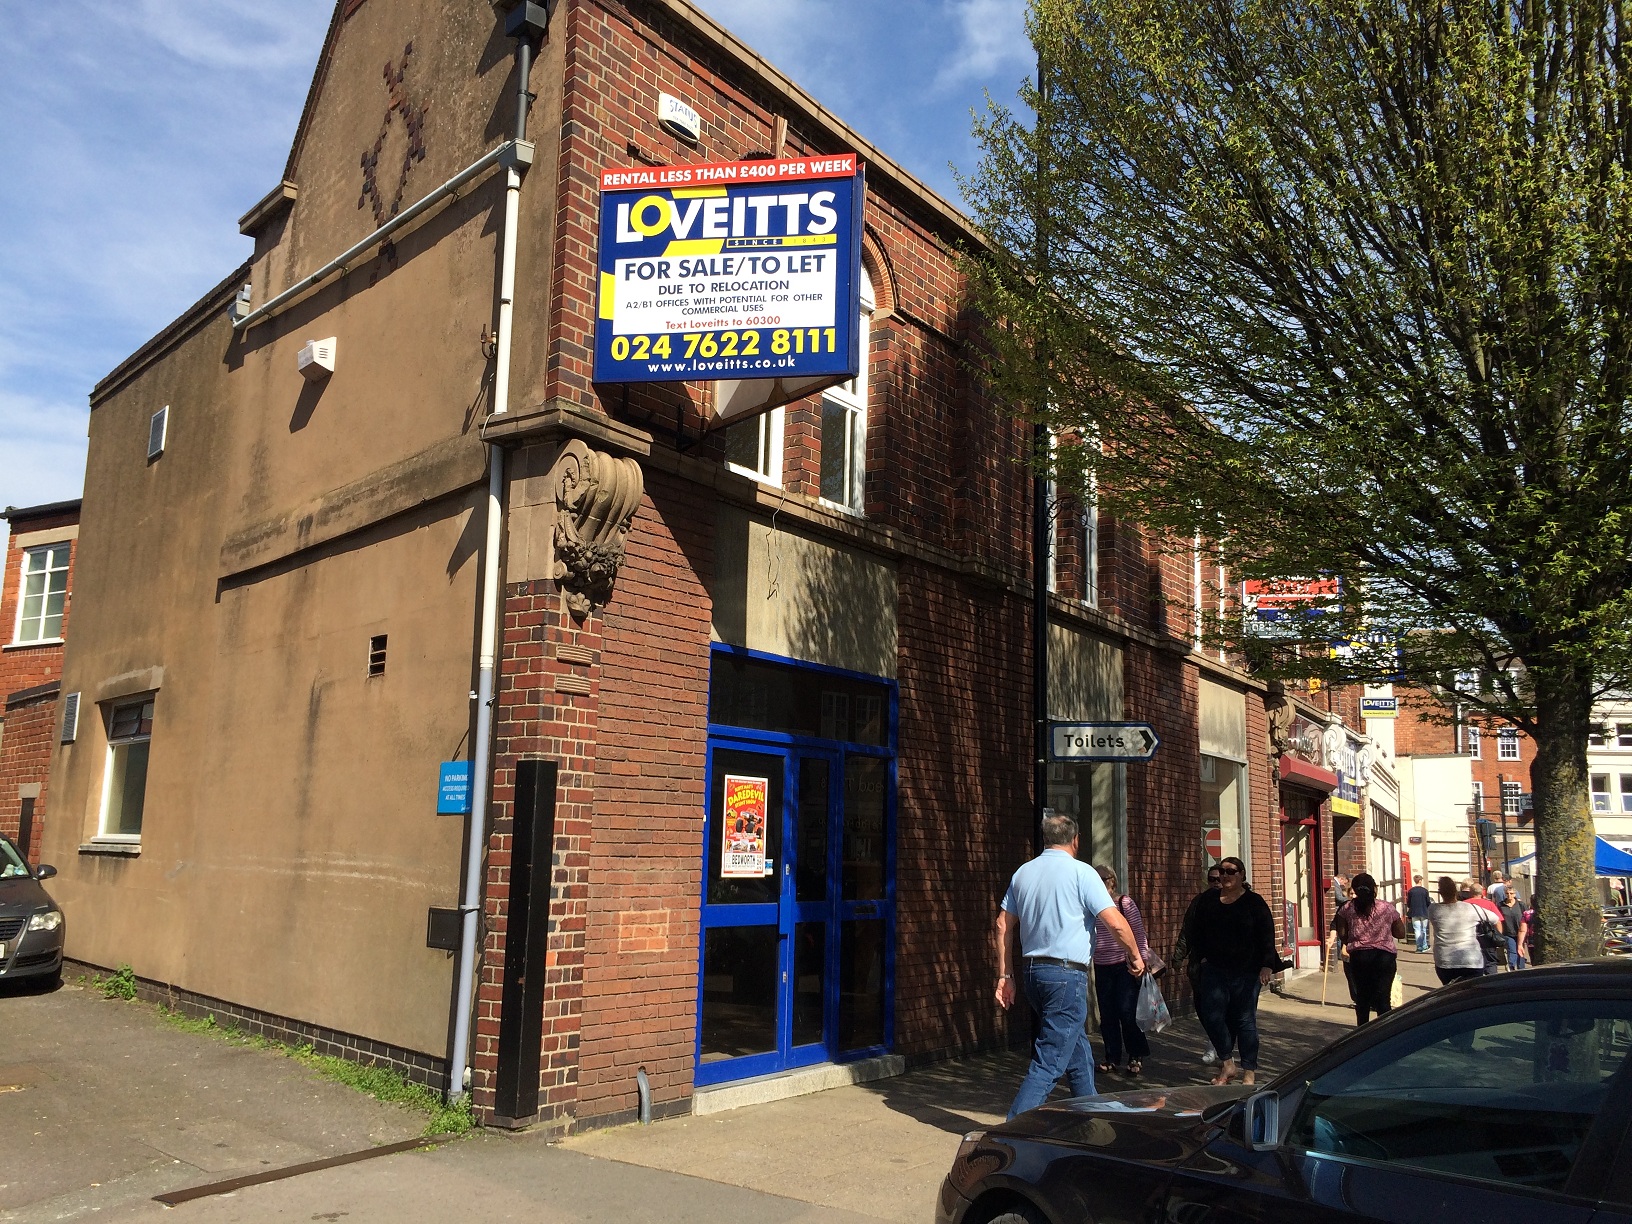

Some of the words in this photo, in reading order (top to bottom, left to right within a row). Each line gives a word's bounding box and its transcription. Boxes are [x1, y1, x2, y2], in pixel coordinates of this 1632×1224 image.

[603, 171, 657, 186] RENTAL
[659, 168, 692, 184] LESS
[696, 166, 738, 180] THAN
[740, 163, 776, 178] £400
[779, 161, 805, 176] PER
[809, 158, 853, 173] WEEK
[616, 190, 838, 244] LOVEITTS
[734, 238, 779, 246] SINCE
[624, 260, 671, 282] FOR
[787, 253, 827, 274] LET
[658, 284, 684, 296] DUE
[688, 282, 706, 294] TO
[710, 280, 790, 293] RELOCATION
[625, 299, 653, 310] A2/B1
[655, 298, 690, 308] OFFICES
[693, 297, 717, 306] WITH
[719, 295, 768, 305] POTENTIAL
[771, 294, 789, 303] FOR
[793, 293, 823, 302] OTHER
[681, 305, 739, 316] COMMERCIAL
[742, 304, 764, 313] USES
[665, 319, 688, 330] Text
[690, 318, 729, 329] Loveitts
[731, 317, 743, 327] to
[746, 315, 781, 326] 60300
[611, 334, 672, 361] 024
[683, 330, 761, 359] 7622
[771, 328, 836, 354] 8111
[648, 356, 796, 374] www.loveitts.co.uk
[1063, 734, 1125, 748] Toilets
[445, 774, 451, 782] NO
[452, 774, 468, 782] PARKING
[728, 789, 765, 806] DAREDEVIL
[732, 854, 756, 865] BEDWORTH
